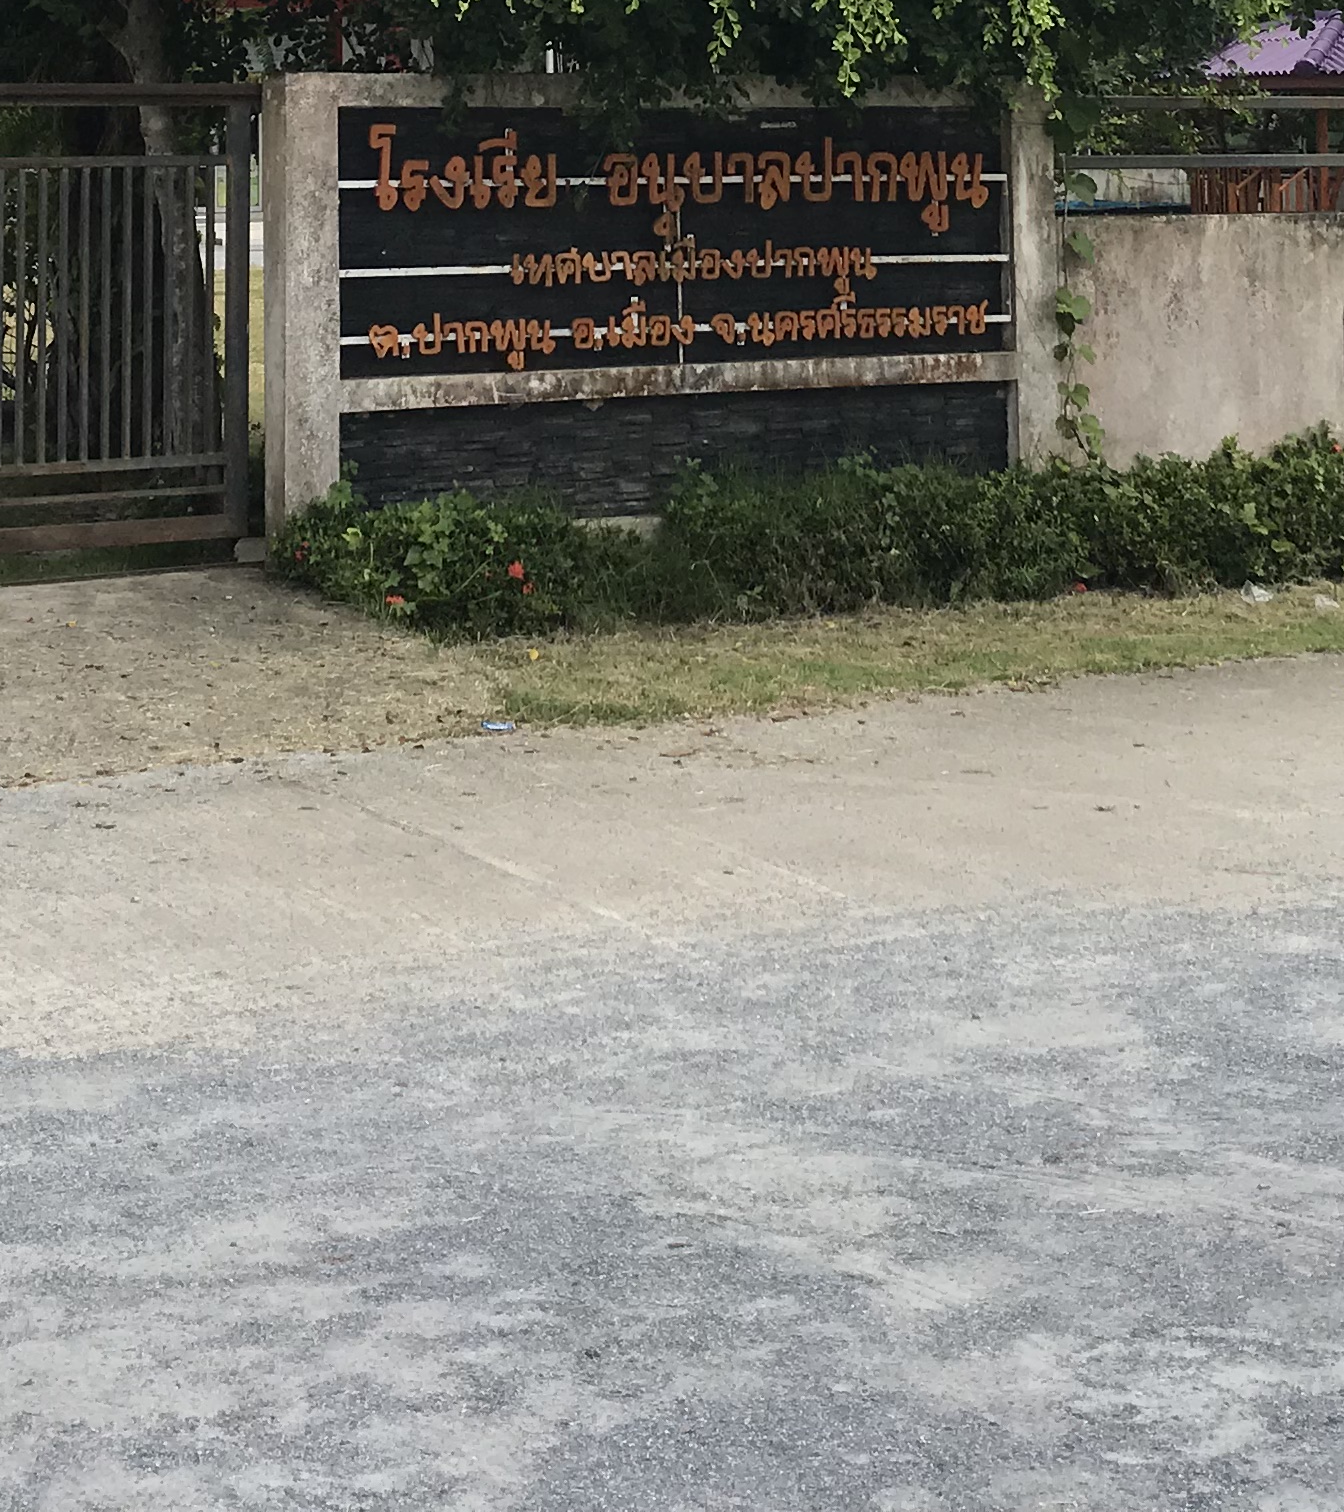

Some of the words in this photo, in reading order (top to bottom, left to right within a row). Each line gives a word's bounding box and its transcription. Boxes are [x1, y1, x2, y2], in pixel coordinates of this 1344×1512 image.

[602, 136, 989, 236] อนุบาลปากพูน
[511, 238, 877, 294] เทศบาลเมืองปากพูน
